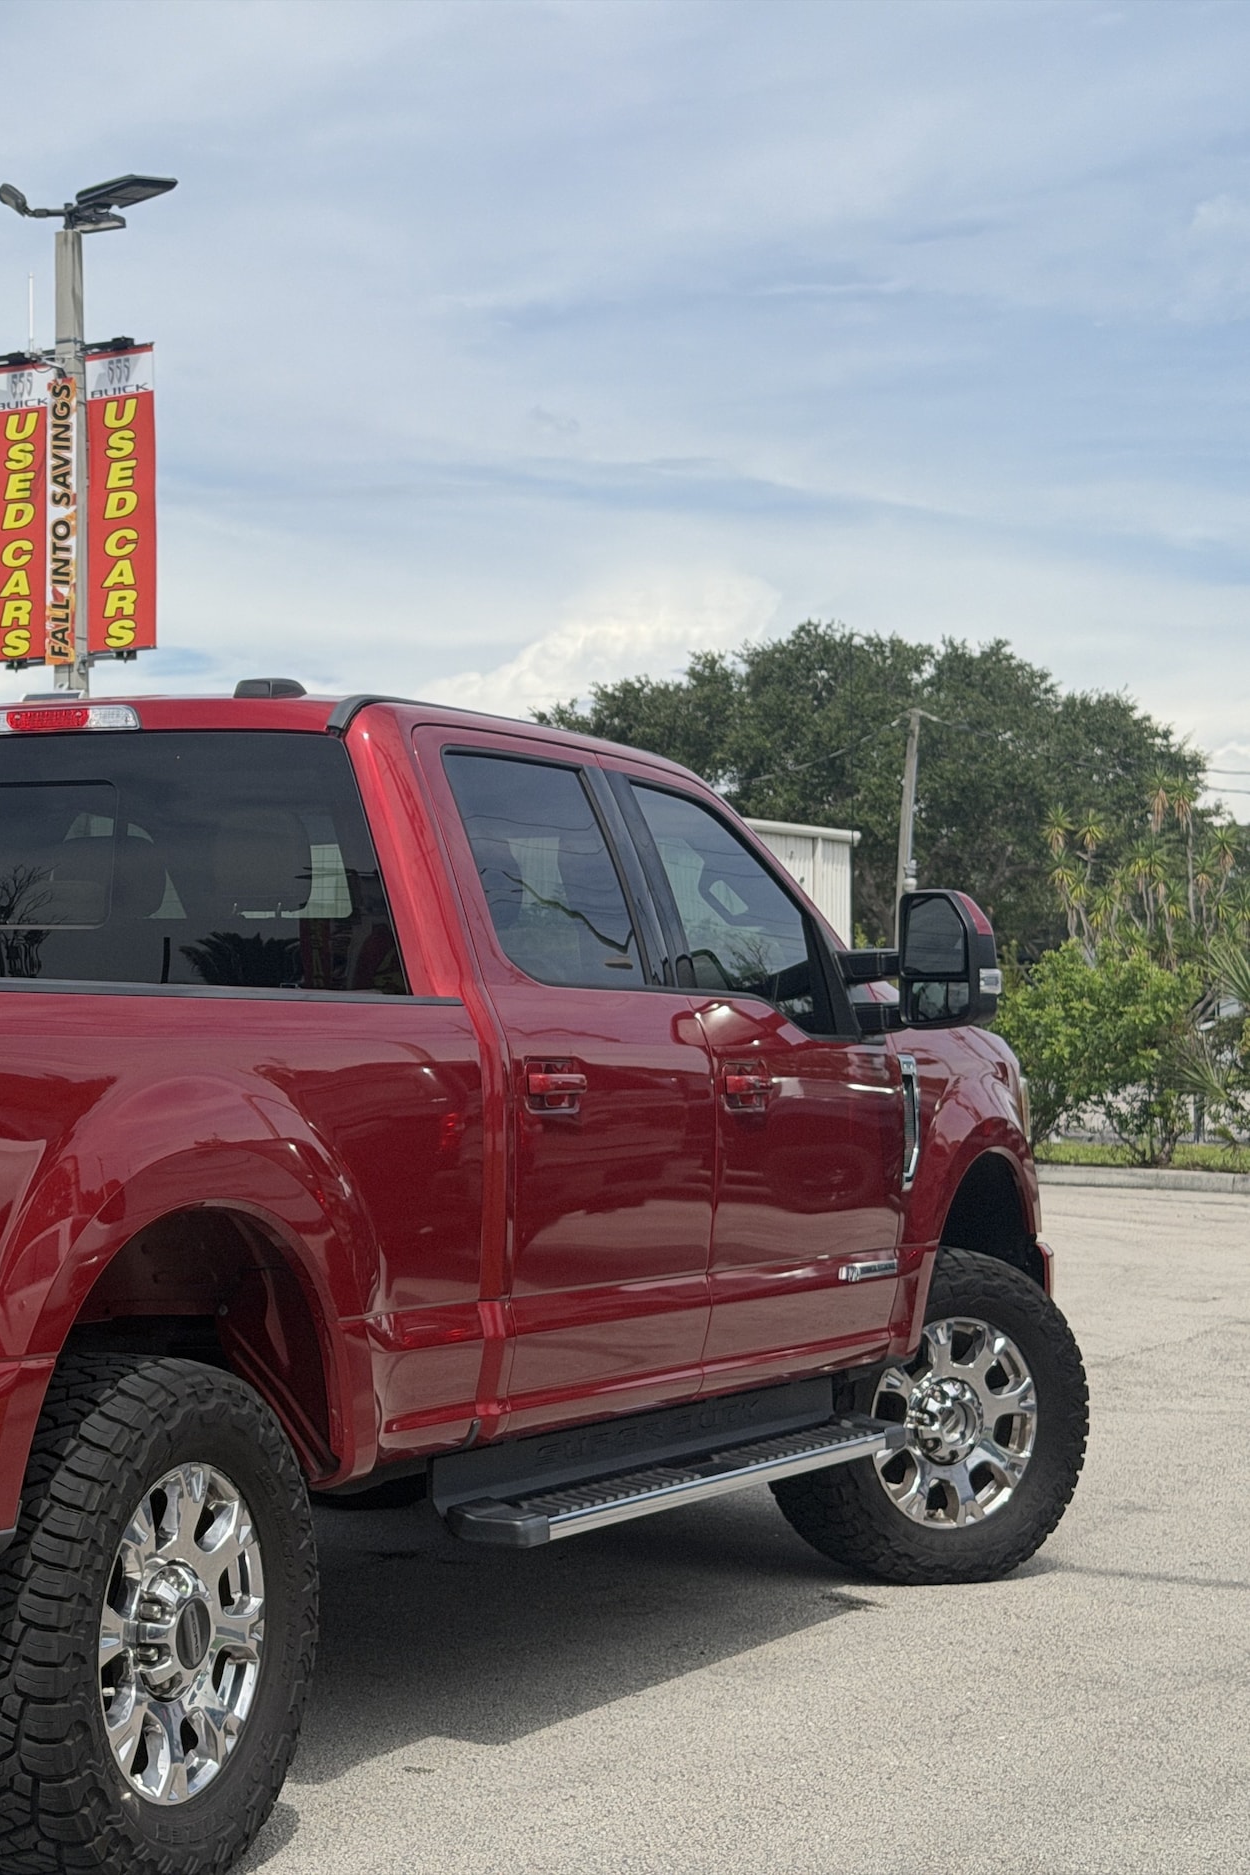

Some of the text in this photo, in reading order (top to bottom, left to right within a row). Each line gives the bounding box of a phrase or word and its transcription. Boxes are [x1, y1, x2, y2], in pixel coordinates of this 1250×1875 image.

[2, 411, 38, 531] USED
[90, 382, 149, 399] BUICK
[50, 382, 72, 660] FALL INTO SAVINGS
[100, 398, 139, 650] USED CARS
